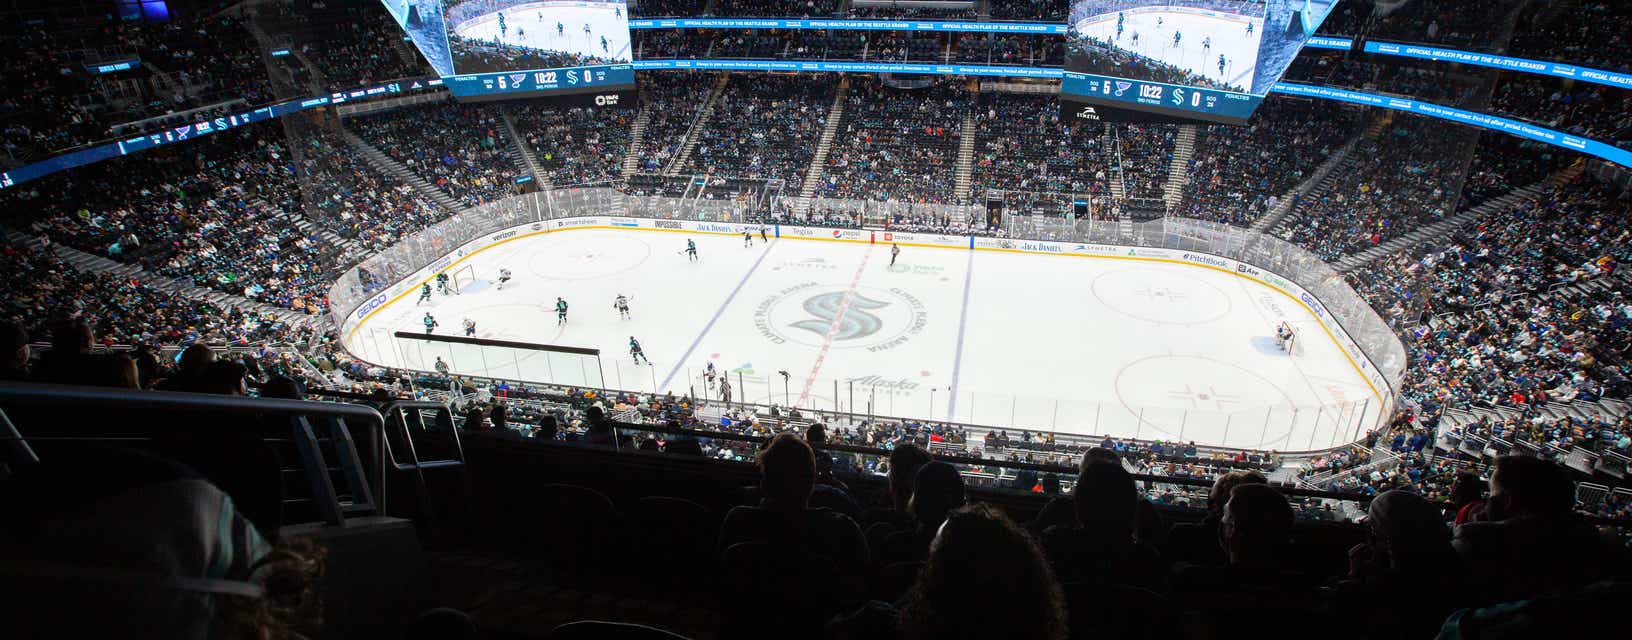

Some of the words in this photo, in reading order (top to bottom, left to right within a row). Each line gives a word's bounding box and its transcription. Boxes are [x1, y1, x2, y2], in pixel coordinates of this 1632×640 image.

[1492, 58, 1519, 66] SEATTLE
[1519, 62, 1546, 70] KRAKEN
[534, 72, 557, 84] 10:22
[584, 70, 592, 82] 0
[1581, 71, 1607, 80] OFFICIAL
[497, 76, 506, 89] 5
[1103, 80, 1111, 94] 5
[1139, 84, 1162, 99] 10:22
[1192, 91, 1201, 107] 0
[655, 220, 682, 229] IMPOSSIBLE
[493, 231, 516, 241] verizon
[1189, 254, 1228, 268] PitchBook
[357, 294, 387, 319] GEICO
[1302, 292, 1323, 317] GEICO
[845, 375, 920, 390] Alaska
